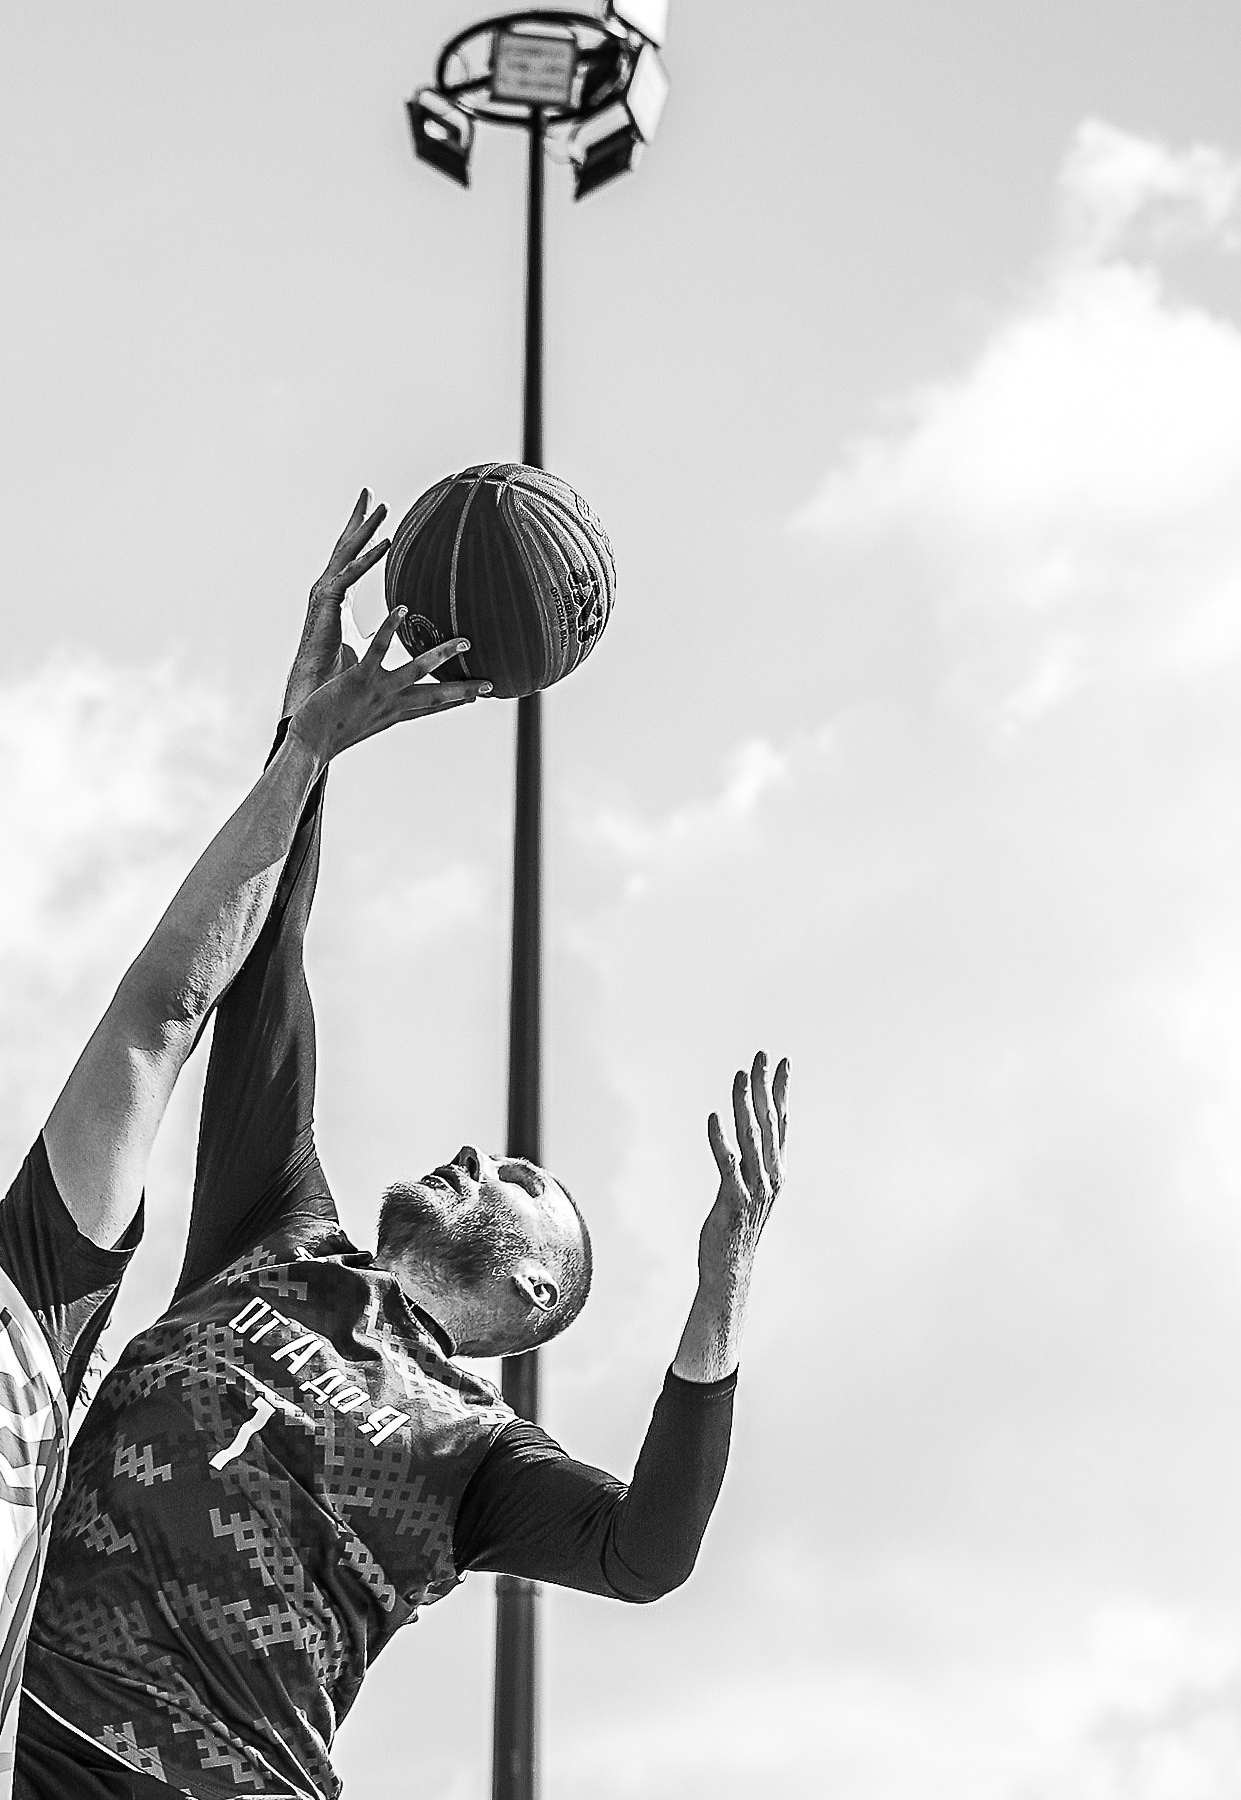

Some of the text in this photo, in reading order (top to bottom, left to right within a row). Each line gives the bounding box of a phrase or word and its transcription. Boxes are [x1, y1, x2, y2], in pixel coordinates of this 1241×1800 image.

[550, 587, 567, 629] OFFICIAL
[229, 1296, 291, 1344] ОТ
[270, 1333, 325, 1375] А
[357, 1404, 411, 1447] Я
